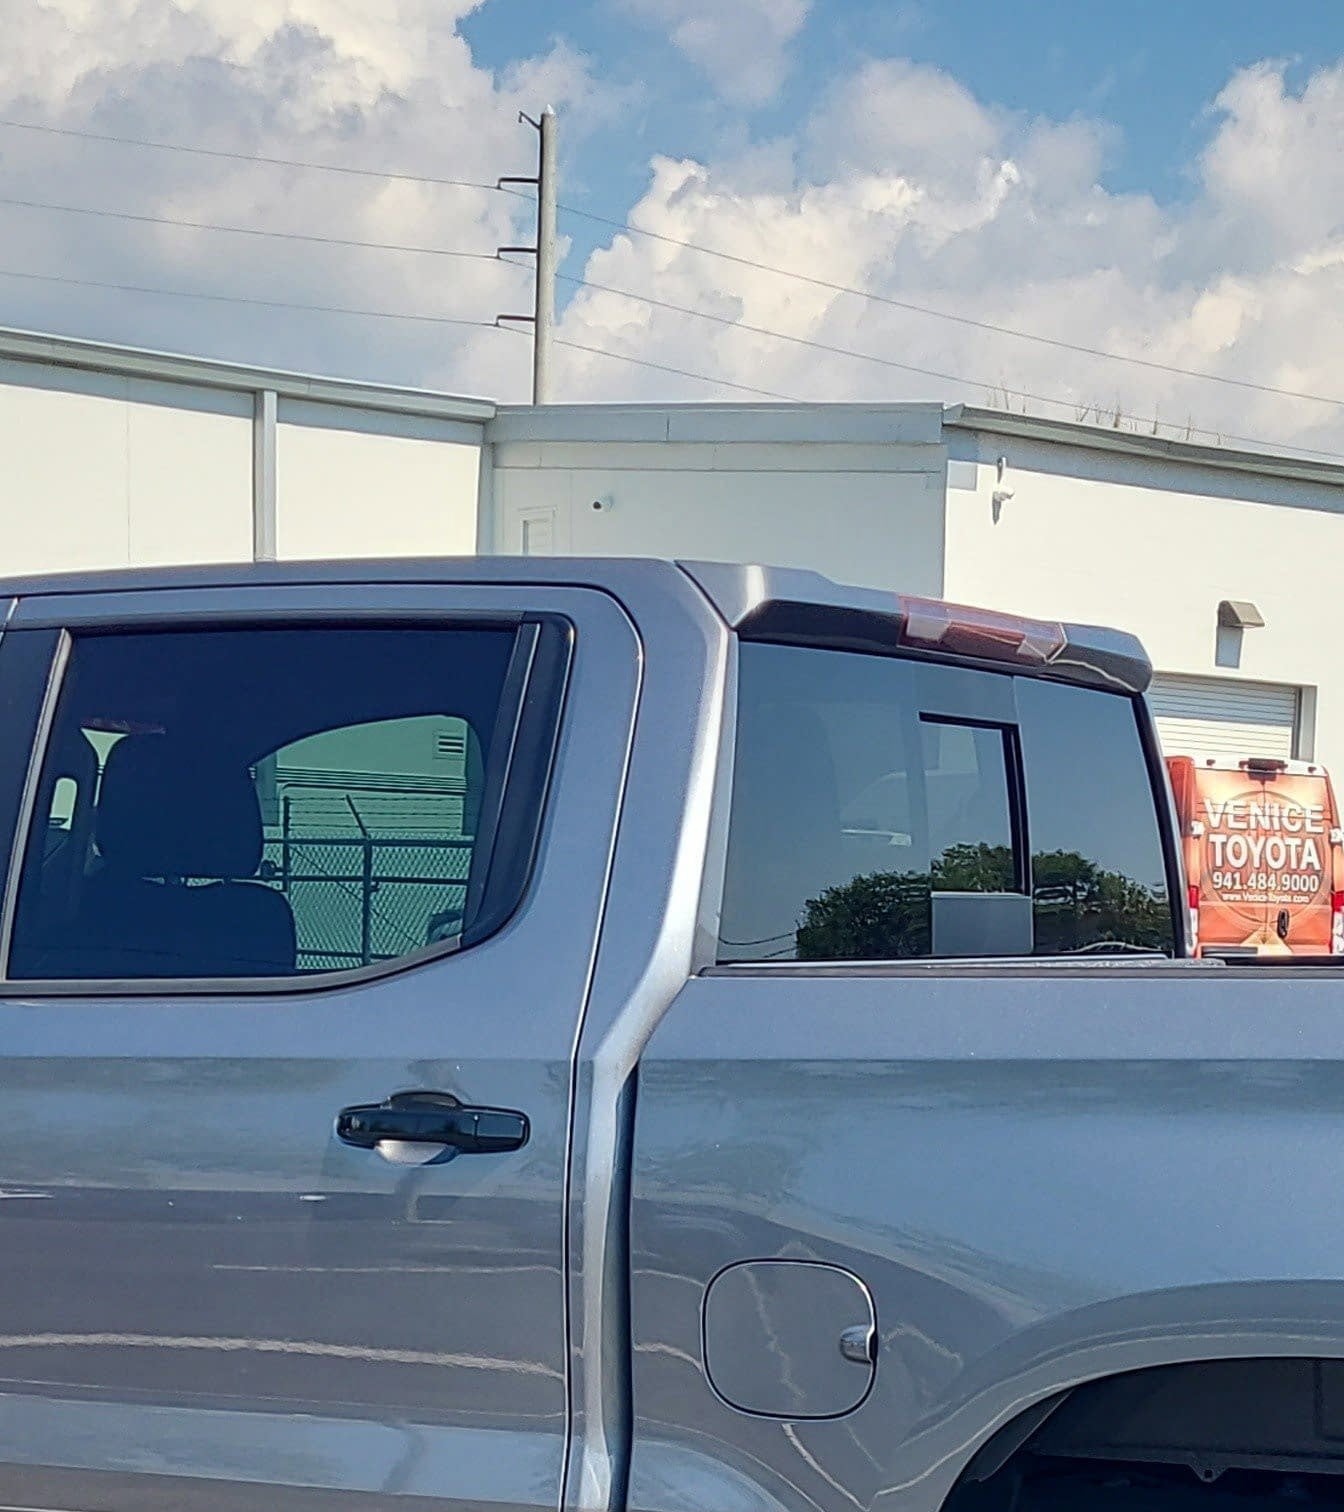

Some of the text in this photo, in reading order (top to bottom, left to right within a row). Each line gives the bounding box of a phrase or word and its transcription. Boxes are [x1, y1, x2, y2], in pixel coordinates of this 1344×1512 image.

[1203, 798, 1324, 833] VENICE
[1209, 834, 1322, 870] TOYOTA
[1212, 871, 1320, 892] 941.484.9000
